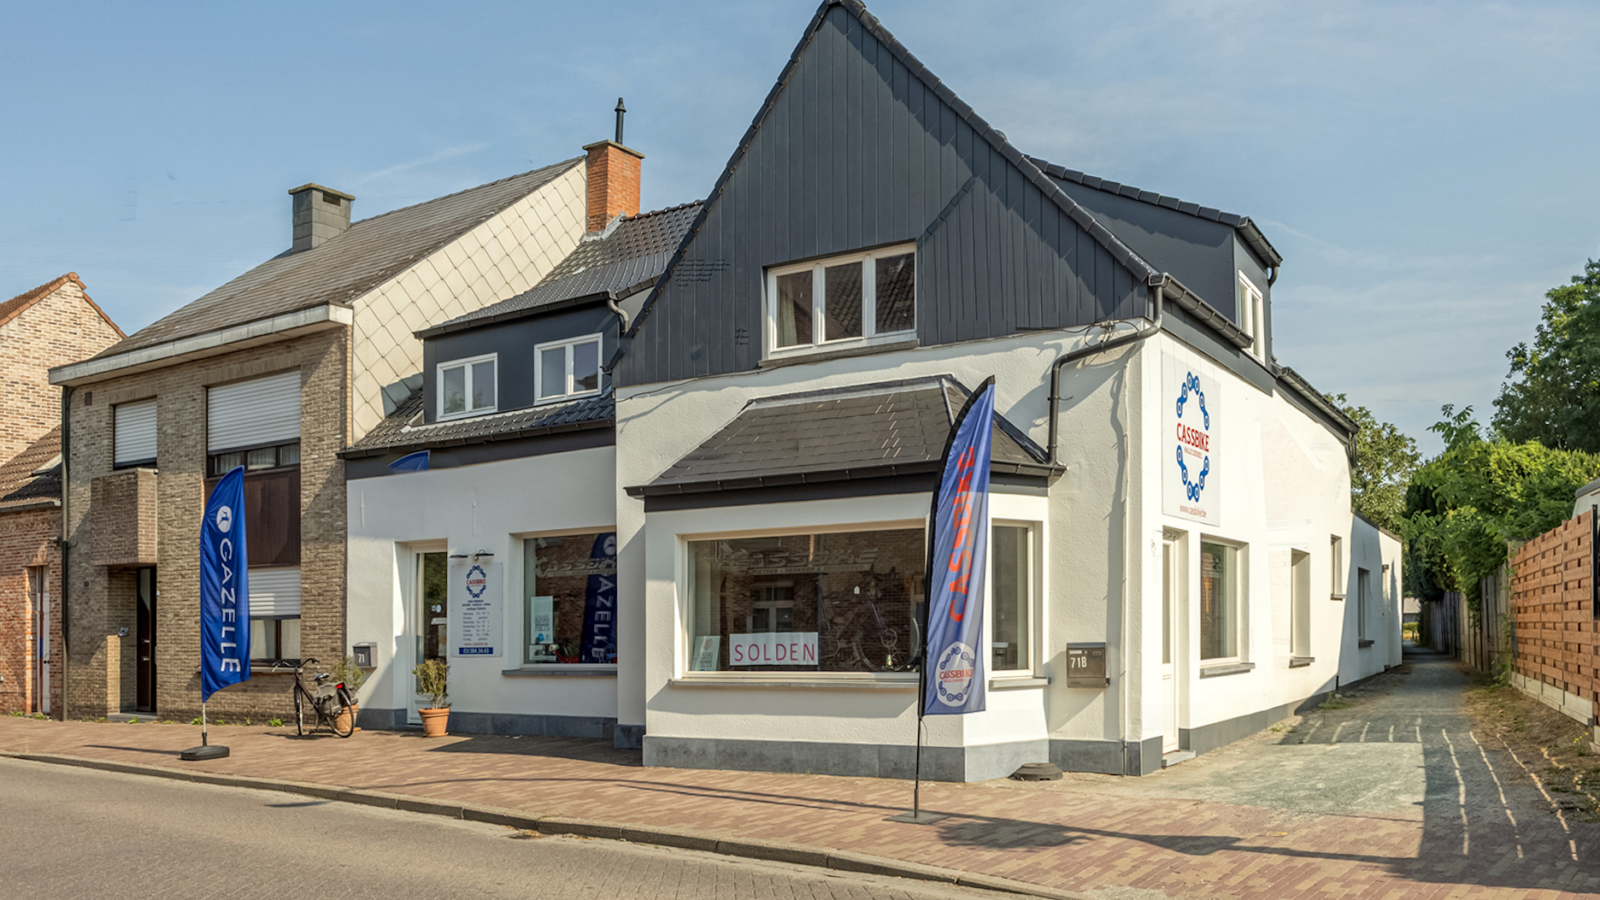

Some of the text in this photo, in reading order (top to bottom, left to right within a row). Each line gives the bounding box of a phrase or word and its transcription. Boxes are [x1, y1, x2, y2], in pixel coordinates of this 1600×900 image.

[1176, 422, 1210, 452] CASSBIKE
[219, 538, 241, 672] GAZELLE
[358, 653, 365, 663] 71
[734, 643, 815, 662] SOLDEN
[1070, 656, 1087, 668] 71B
